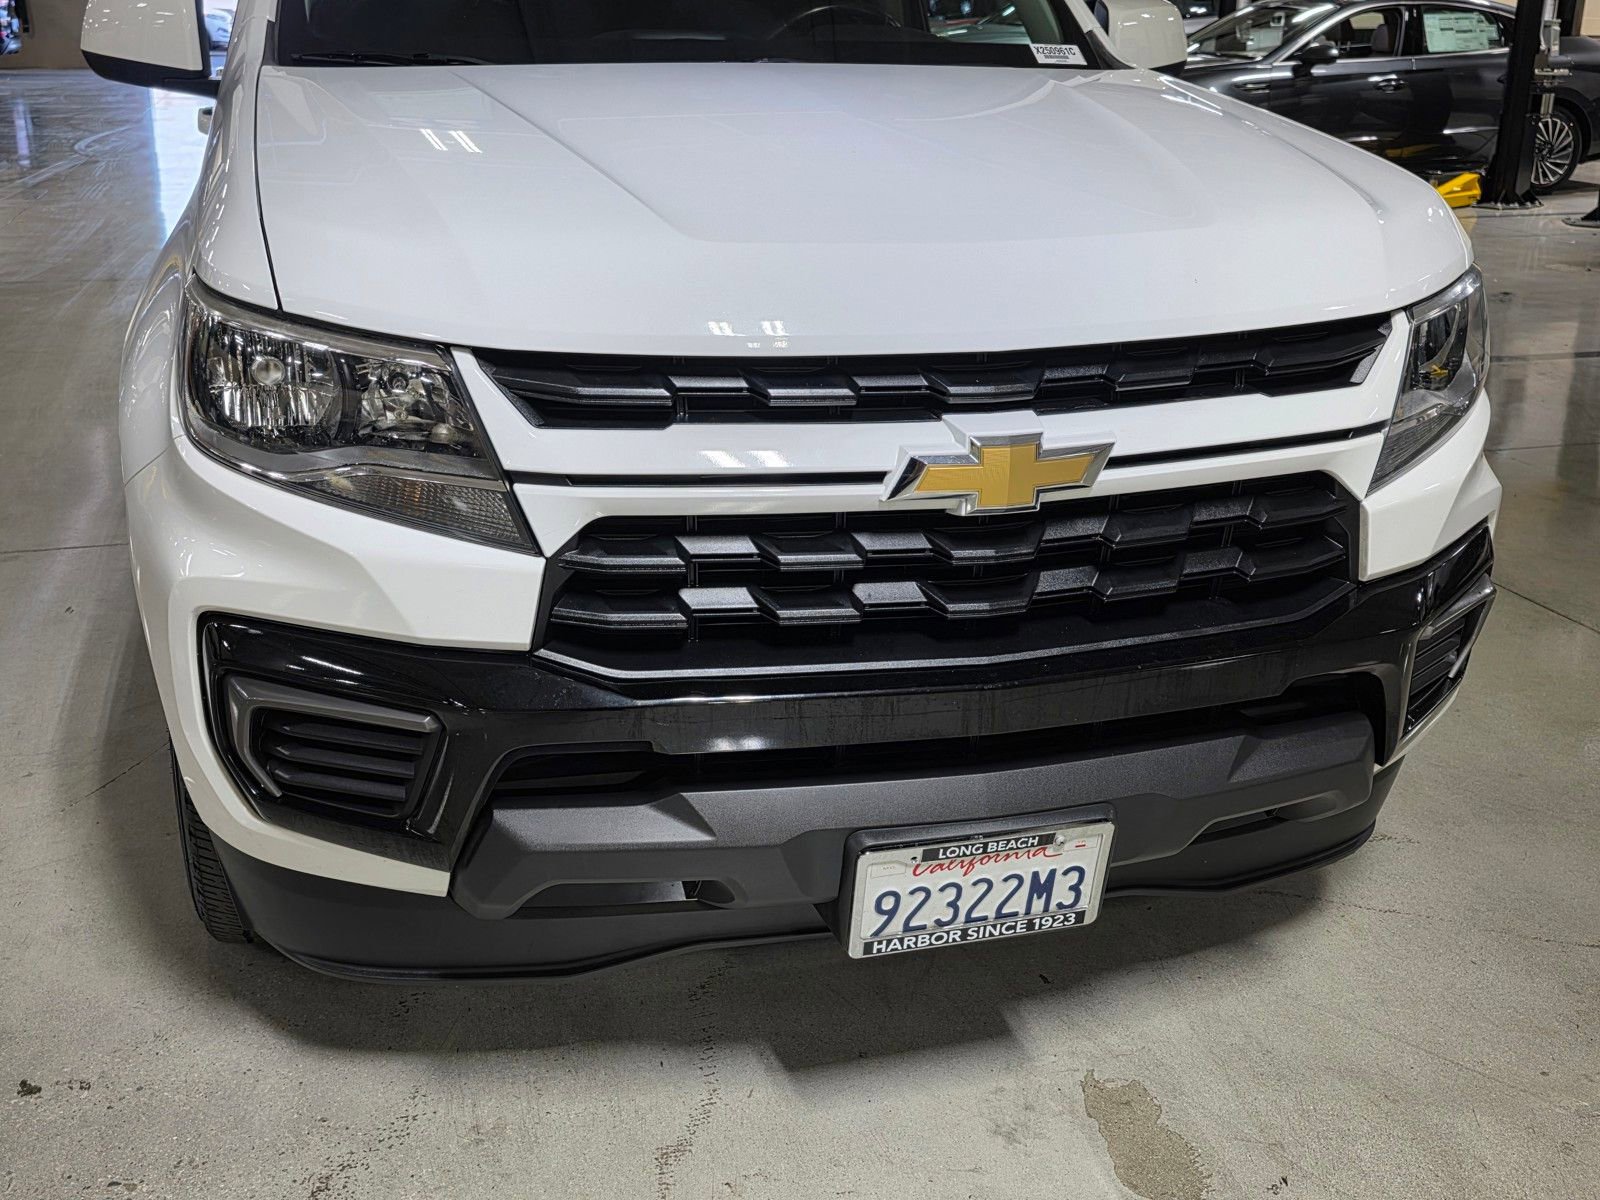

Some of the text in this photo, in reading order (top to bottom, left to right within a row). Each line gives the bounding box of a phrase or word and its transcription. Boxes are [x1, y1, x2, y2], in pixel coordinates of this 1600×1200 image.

[938, 844, 984, 859] LONG
[987, 836, 1039, 853] BEACH
[869, 865, 1086, 937] 92322M3
[872, 913, 1076, 954] HARBOR SINCE 1923
